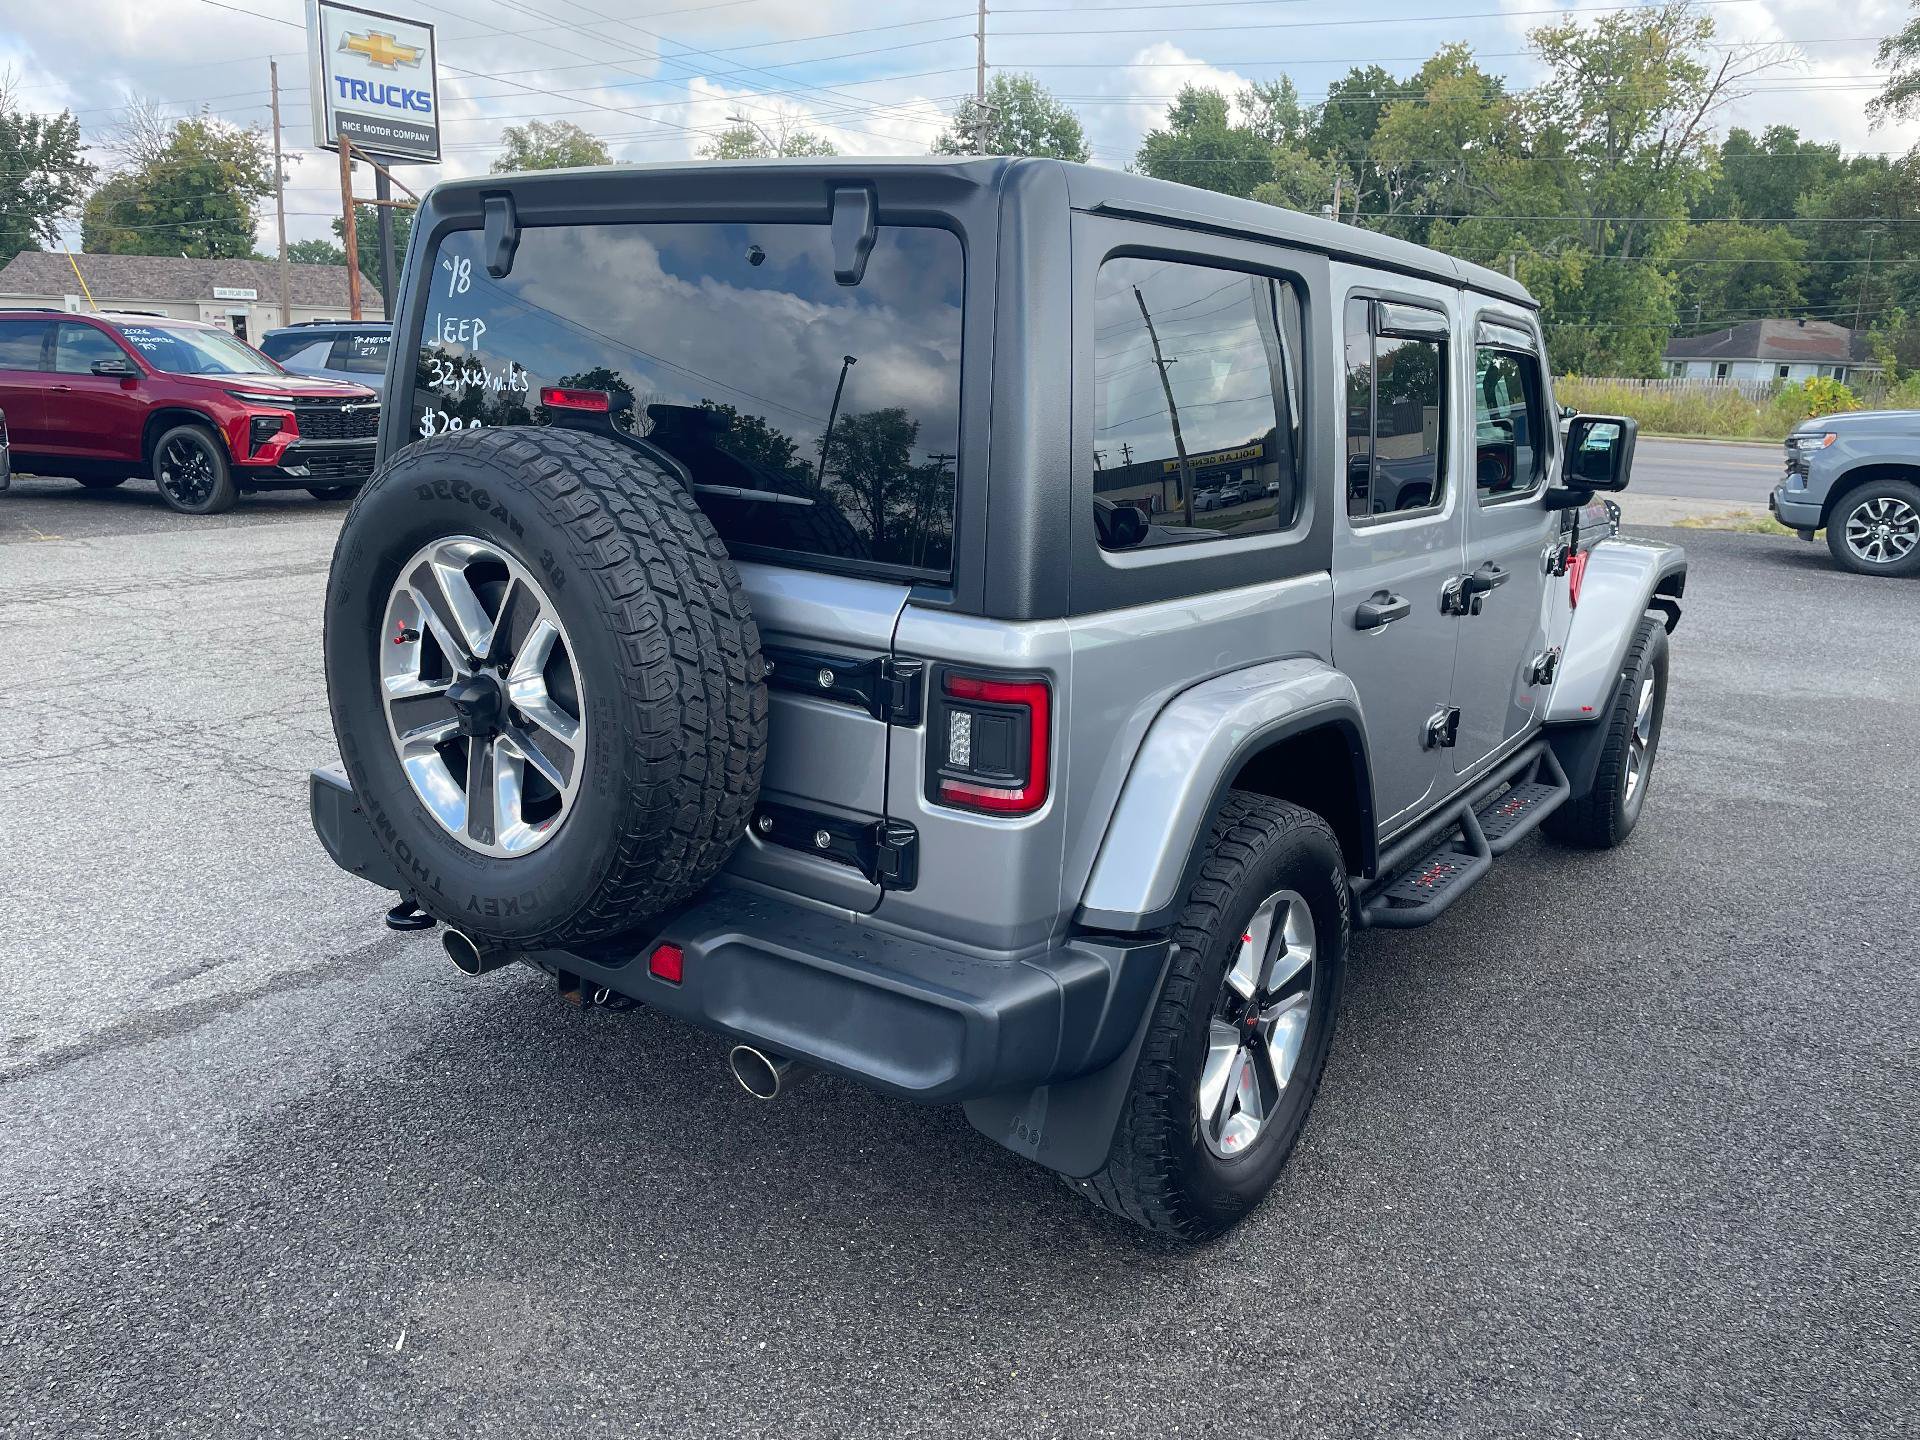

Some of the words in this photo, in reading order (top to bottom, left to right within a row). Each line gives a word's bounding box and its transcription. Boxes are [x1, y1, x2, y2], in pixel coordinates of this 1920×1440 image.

[334, 75, 432, 113] TRUCKS
[342, 121, 361, 132] RICE
[363, 124, 391, 137] MOTOR
[393, 129, 430, 142] COMPANY
[427, 312, 487, 351] JEEP
